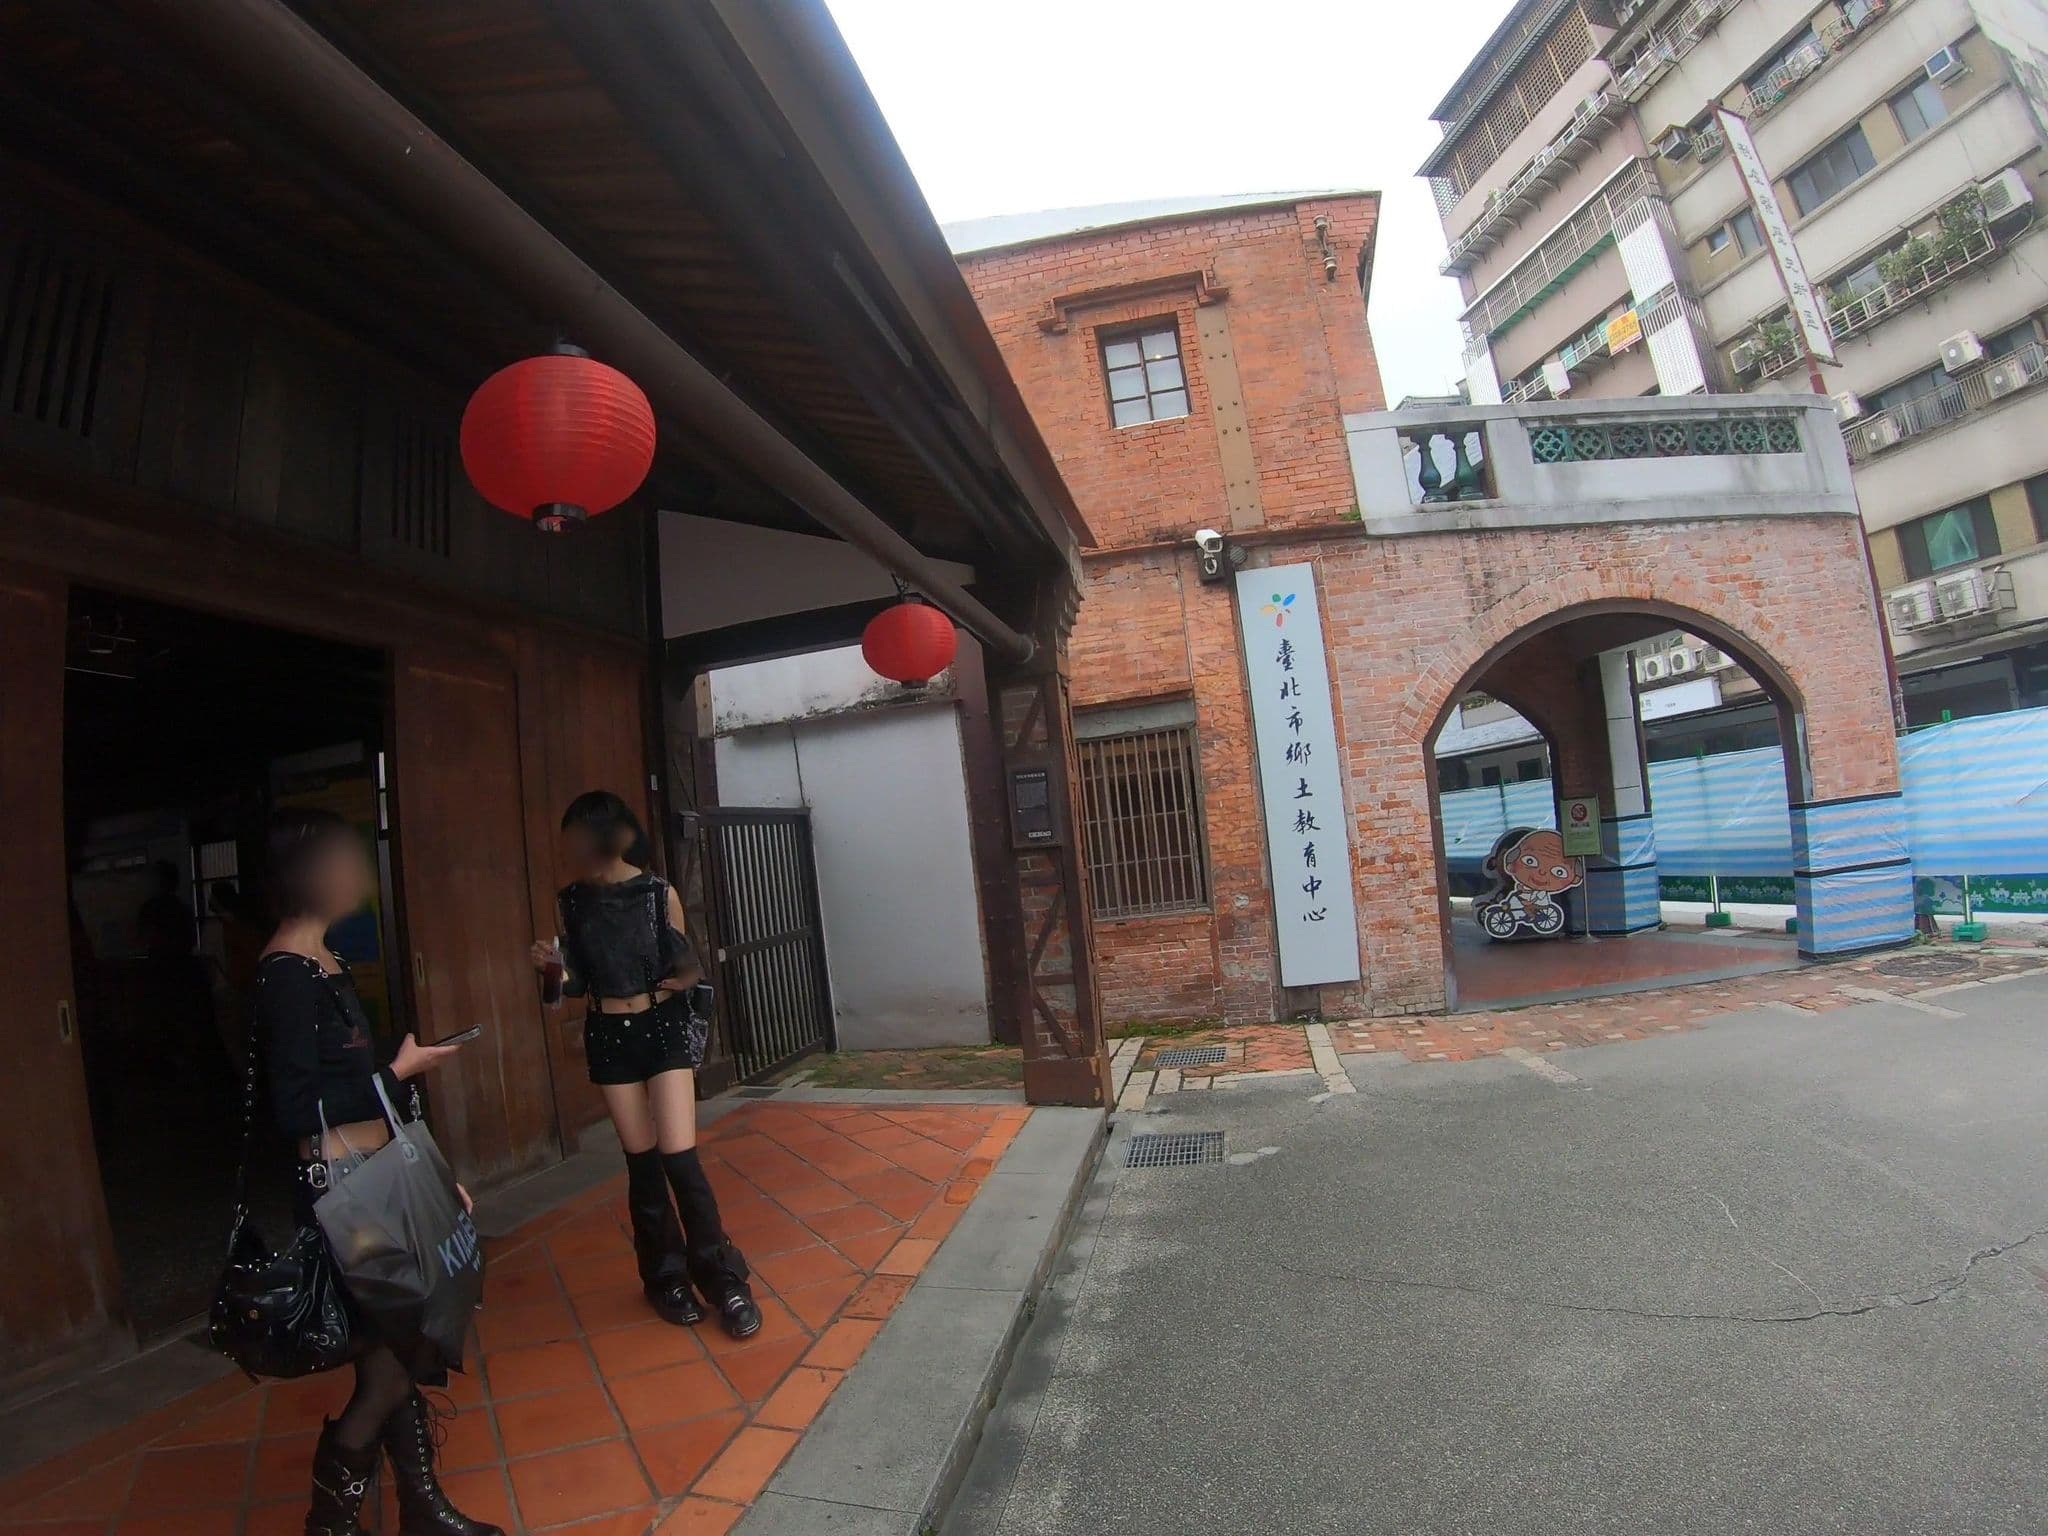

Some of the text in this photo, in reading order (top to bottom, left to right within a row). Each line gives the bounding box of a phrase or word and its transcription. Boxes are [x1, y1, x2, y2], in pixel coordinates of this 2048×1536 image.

[1275, 638, 1328, 922] 臺北市鄉土教育中心
